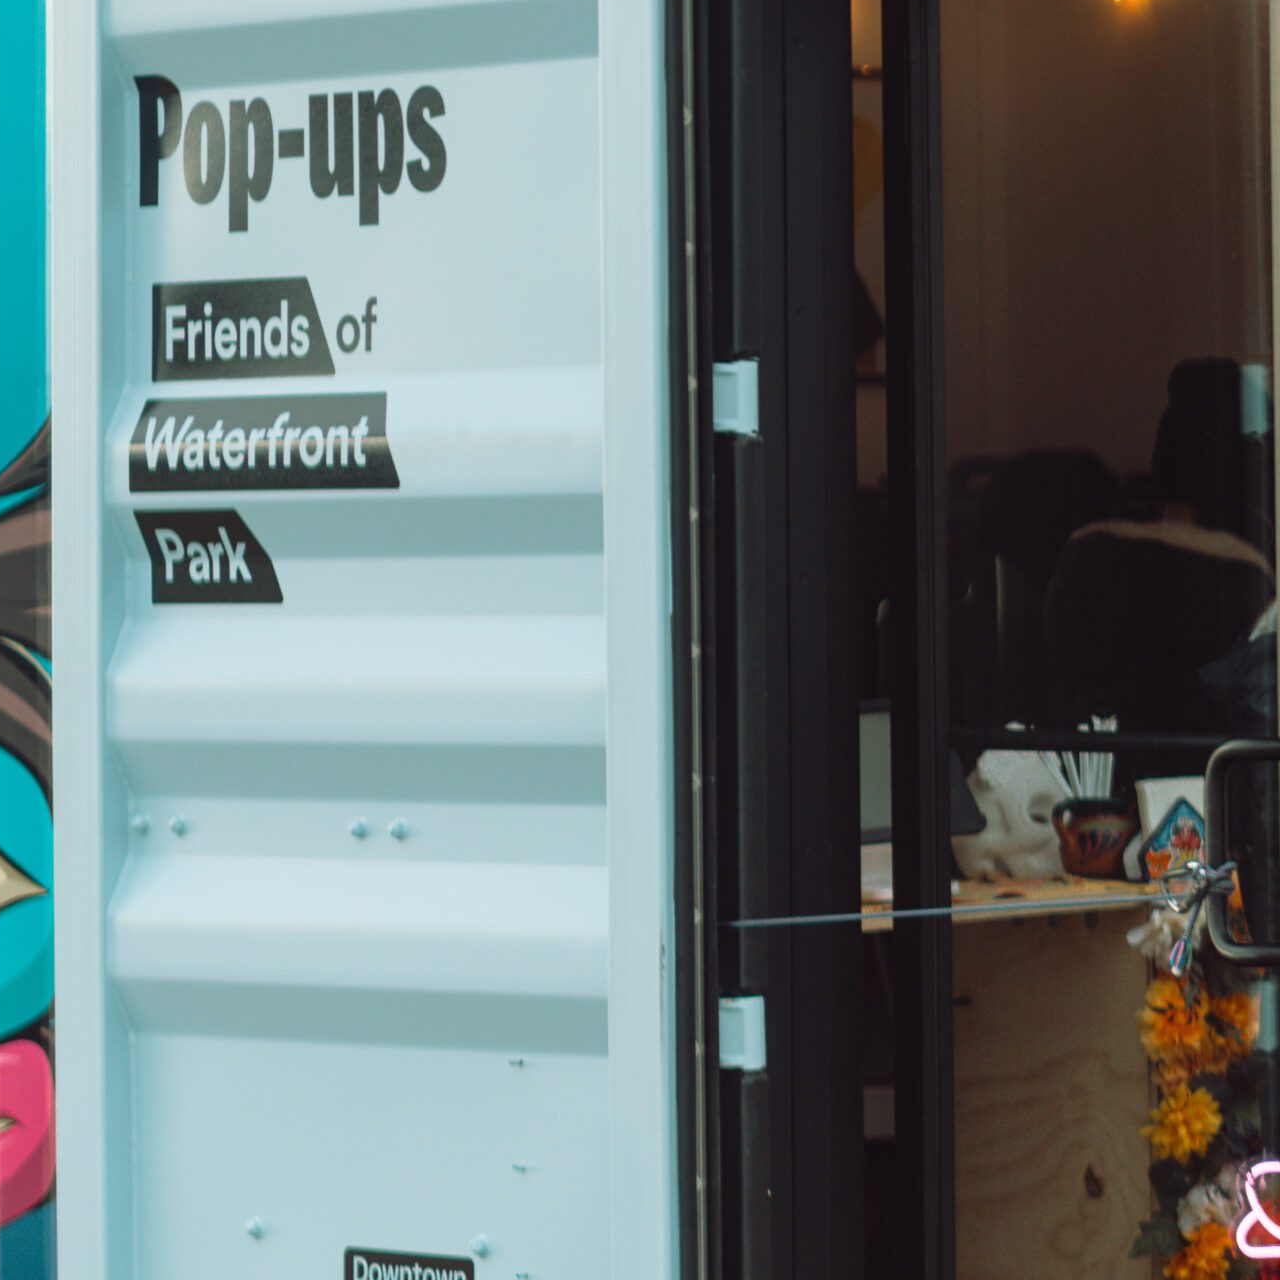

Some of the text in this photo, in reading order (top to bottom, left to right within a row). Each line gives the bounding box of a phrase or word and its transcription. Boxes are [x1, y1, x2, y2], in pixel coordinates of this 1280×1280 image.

[133, 75, 447, 232] Pop-ups
[165, 296, 378, 362] Friends of
[143, 412, 369, 471] Waterfront
[154, 526, 252, 583] Park
[352, 1255, 467, 1280] Downtown
